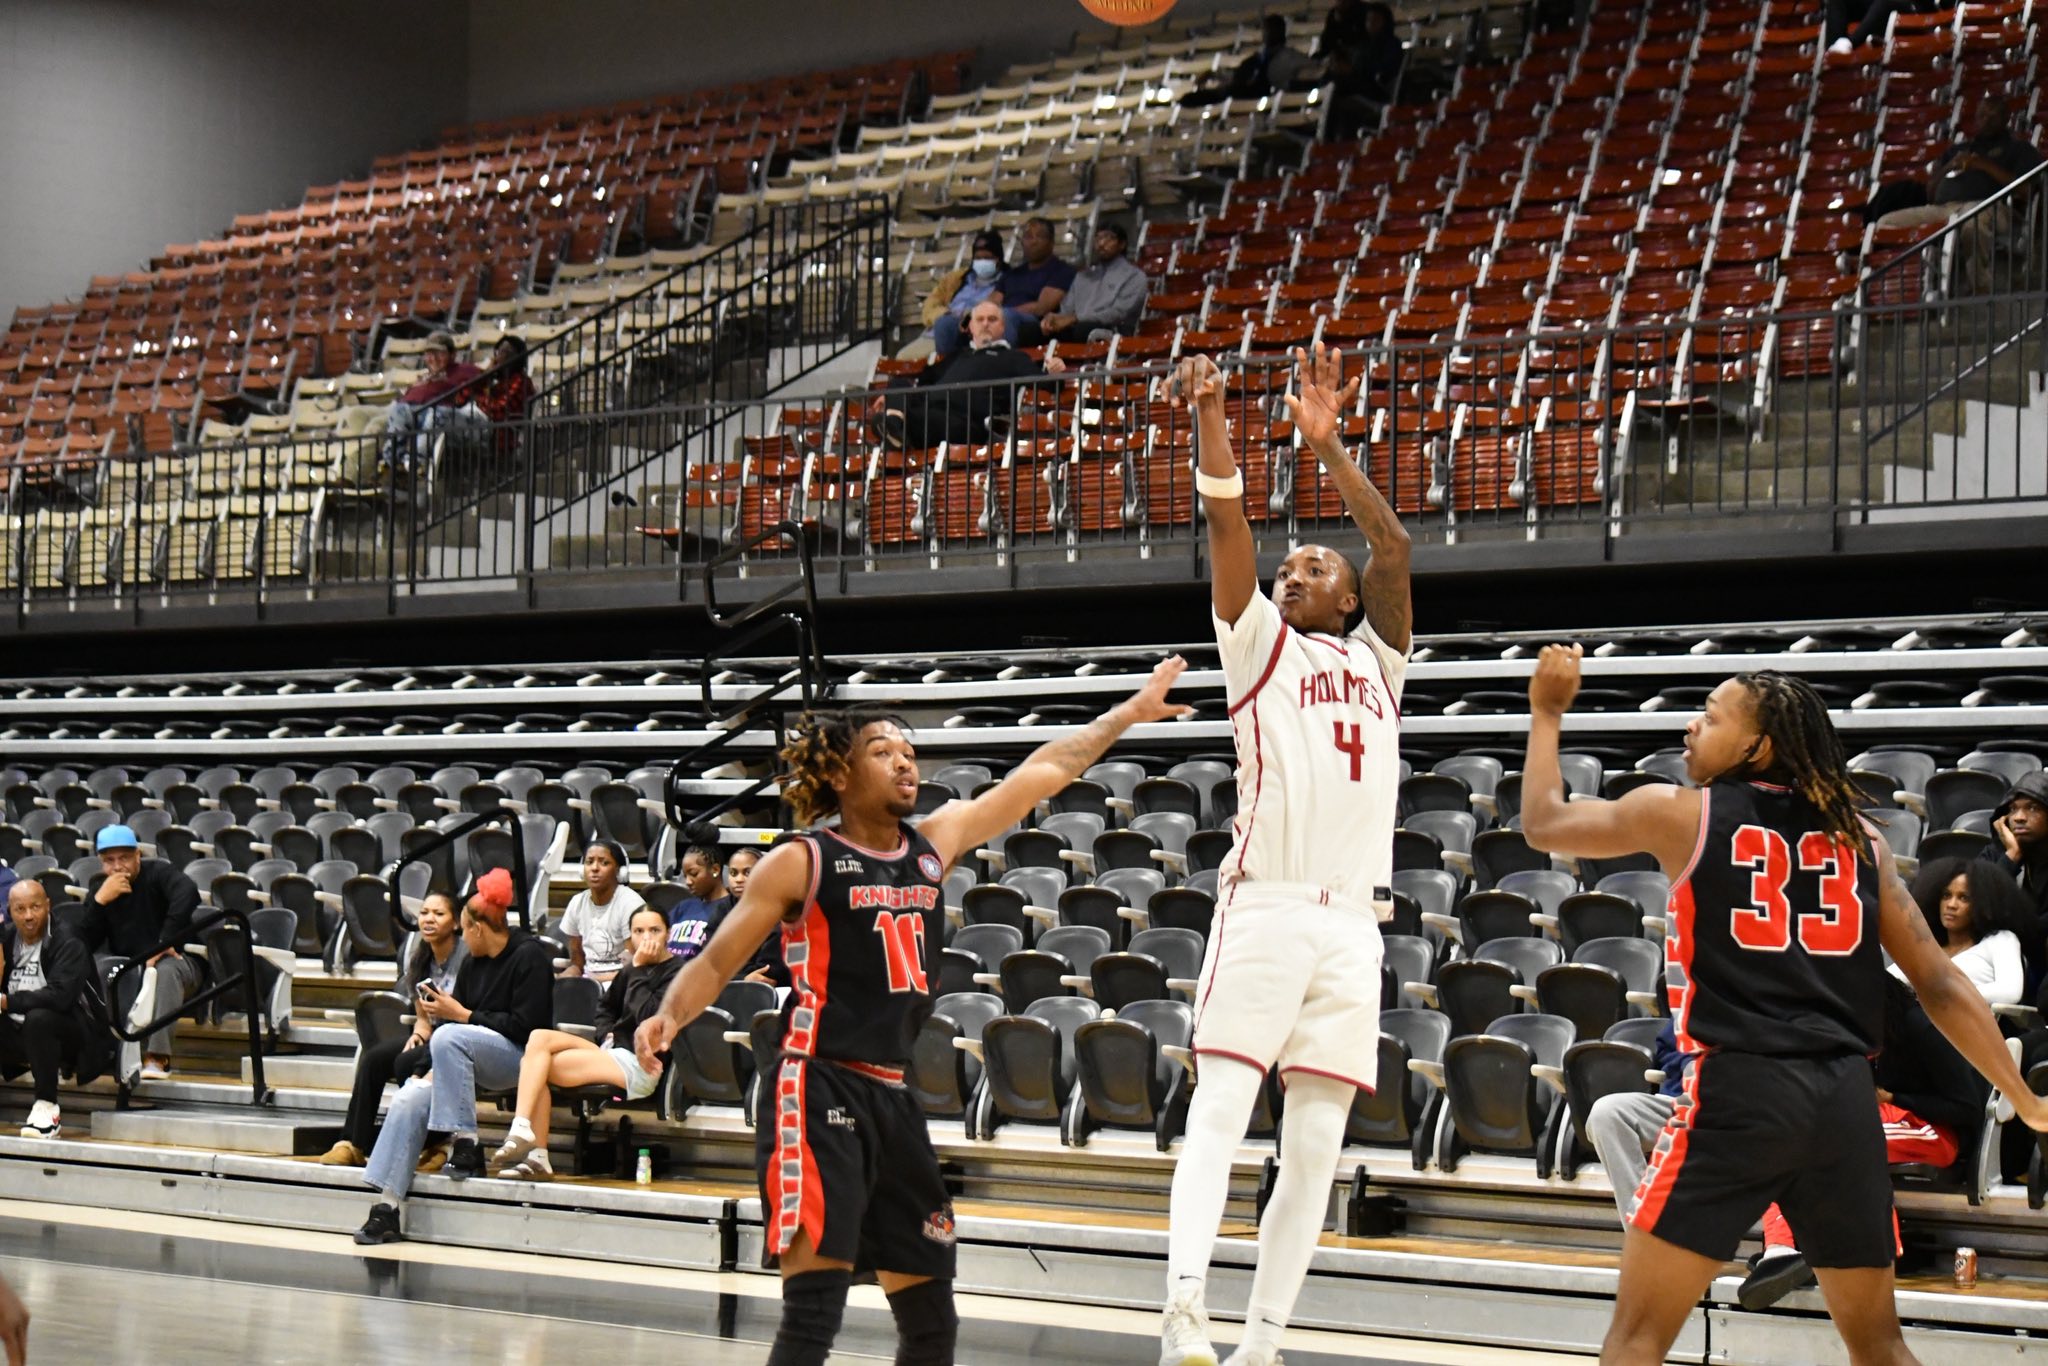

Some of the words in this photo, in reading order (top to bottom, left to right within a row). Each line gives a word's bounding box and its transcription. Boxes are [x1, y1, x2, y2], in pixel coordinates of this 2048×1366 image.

[1300, 669, 1383, 720] HOLMES
[1333, 721, 1365, 782] 4
[850, 885, 939, 910] KNIGHTS
[1730, 824, 1863, 956] 33
